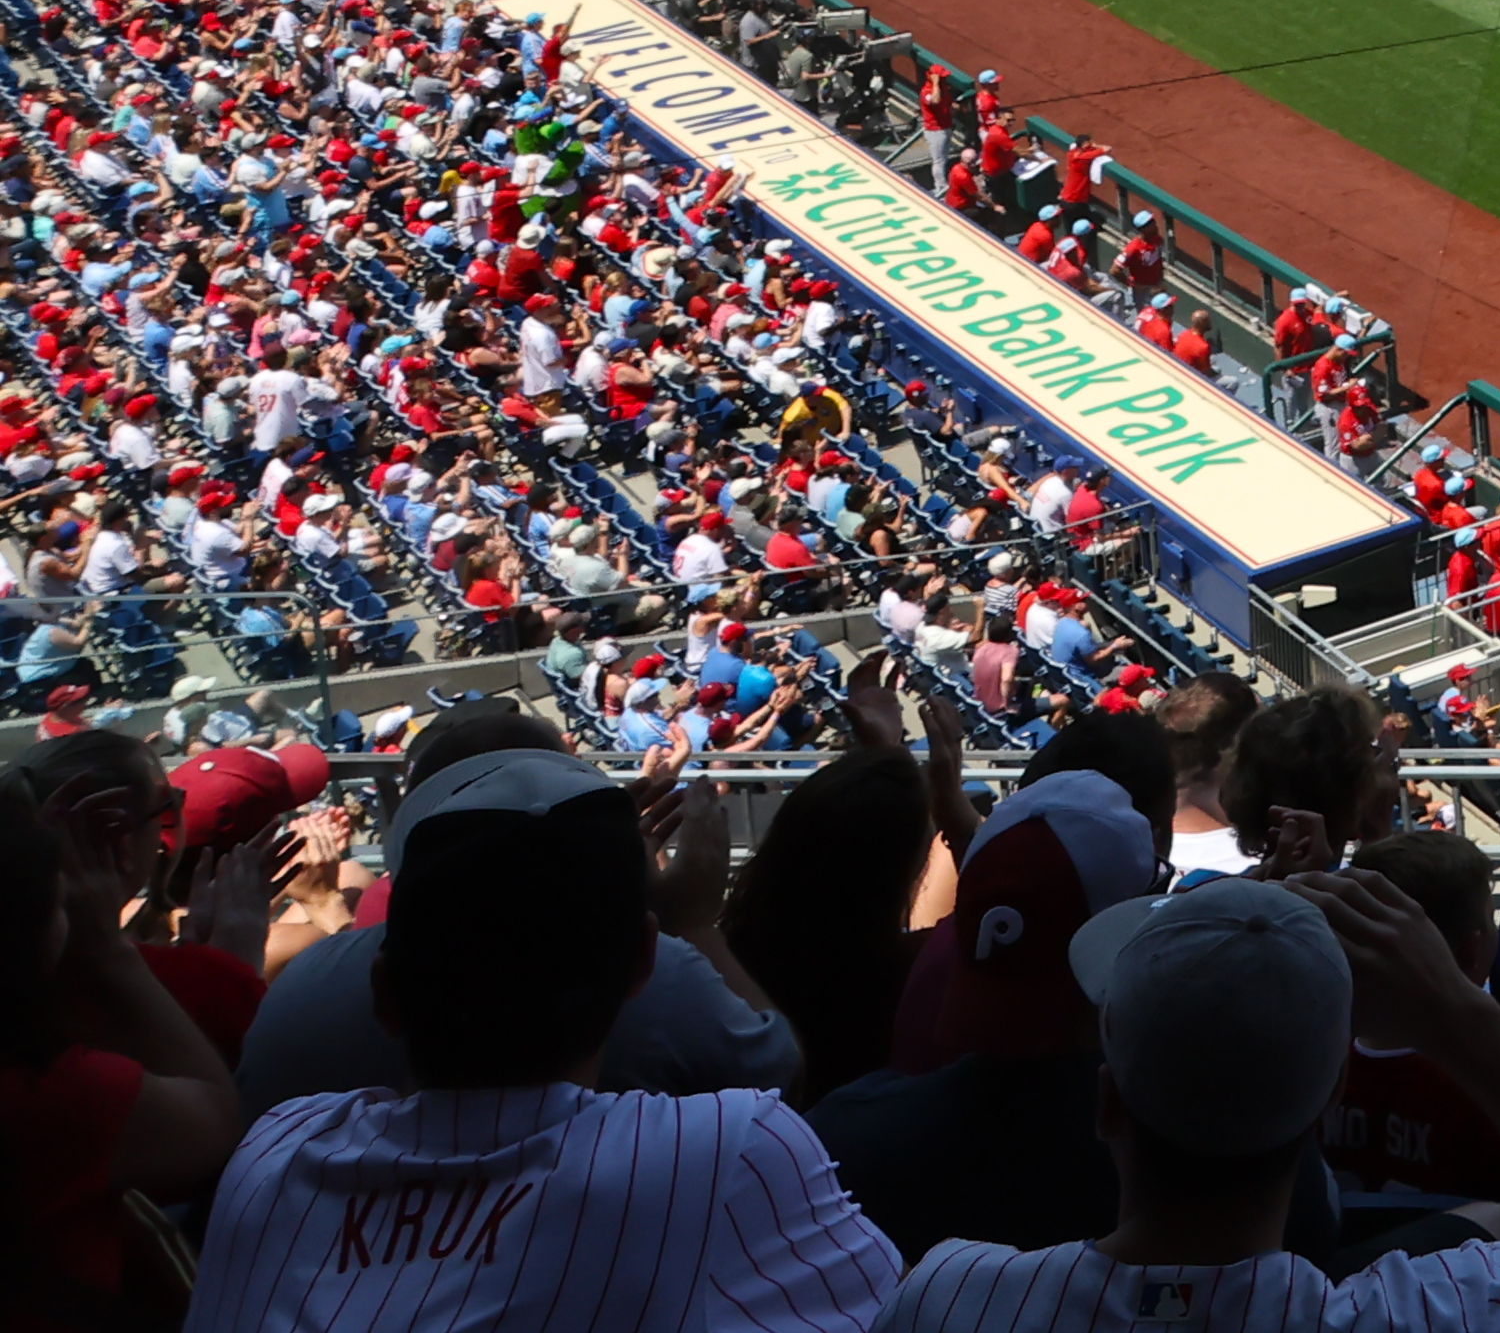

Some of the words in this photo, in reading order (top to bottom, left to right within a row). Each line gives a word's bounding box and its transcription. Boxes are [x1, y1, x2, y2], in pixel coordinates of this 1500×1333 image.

[570, 18, 790, 155] WELCOME
[803, 188, 1010, 315] Citizens
[983, 299, 1130, 406] Bank
[1079, 379, 1257, 486] Park
[1384, 1112, 1434, 1166] SIX
[336, 1175, 534, 1275] KRUK
